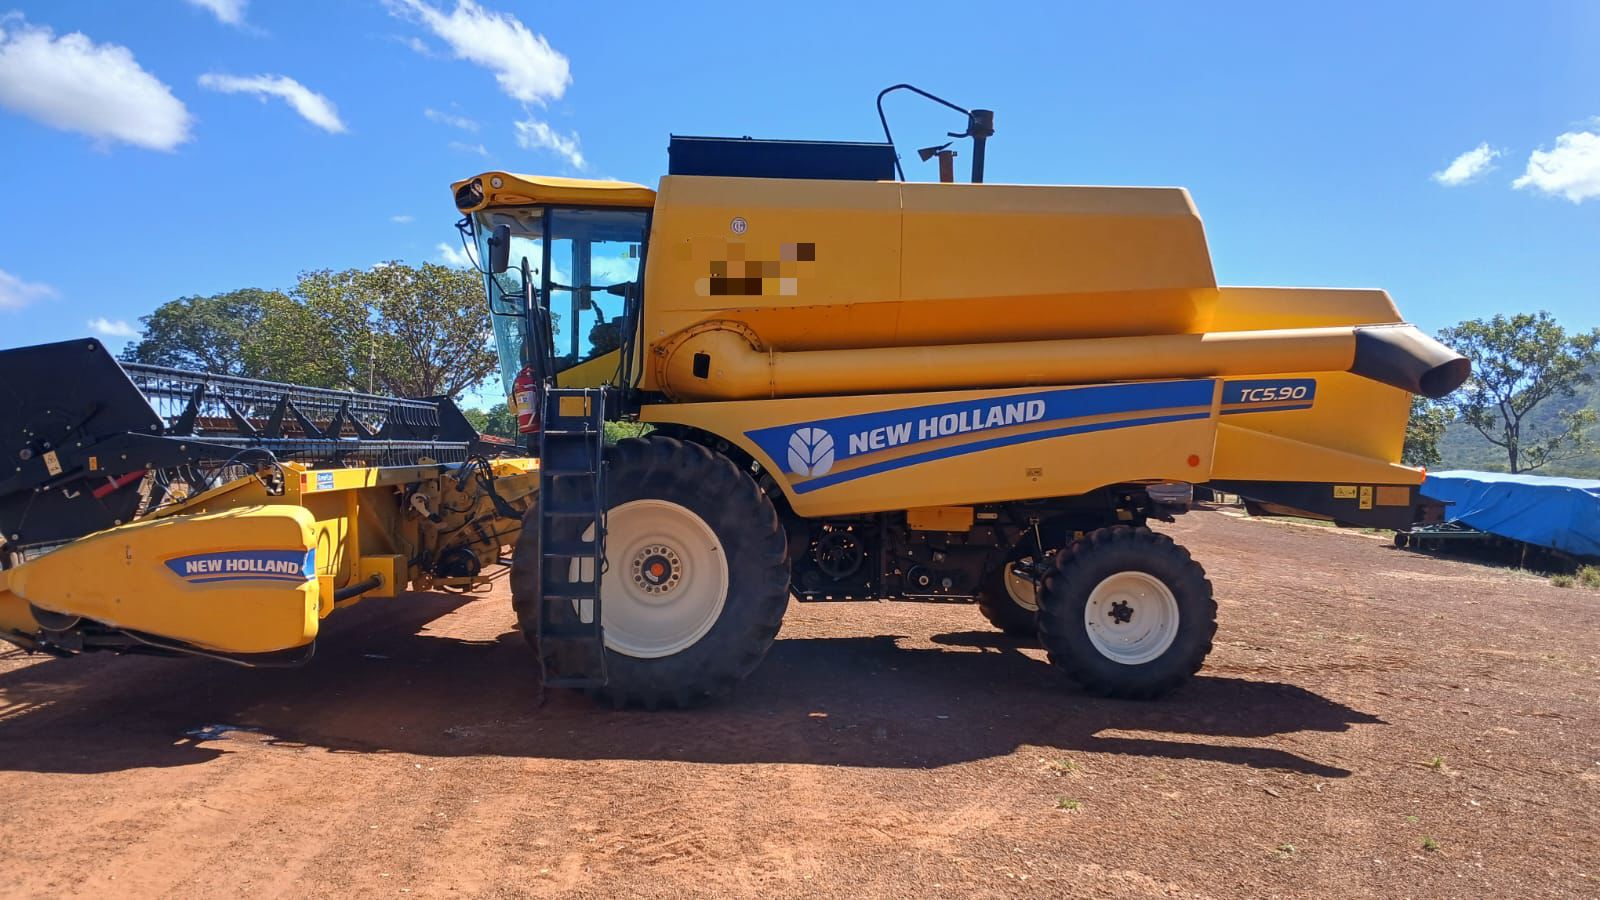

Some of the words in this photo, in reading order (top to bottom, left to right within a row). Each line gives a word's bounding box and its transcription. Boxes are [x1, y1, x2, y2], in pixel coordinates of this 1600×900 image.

[1240, 386, 1307, 402] TC5.90
[848, 421, 913, 455] NEW
[918, 399, 1046, 441] HOLLAND
[185, 559, 222, 574] NEW
[226, 558, 299, 575] HOLLAND
